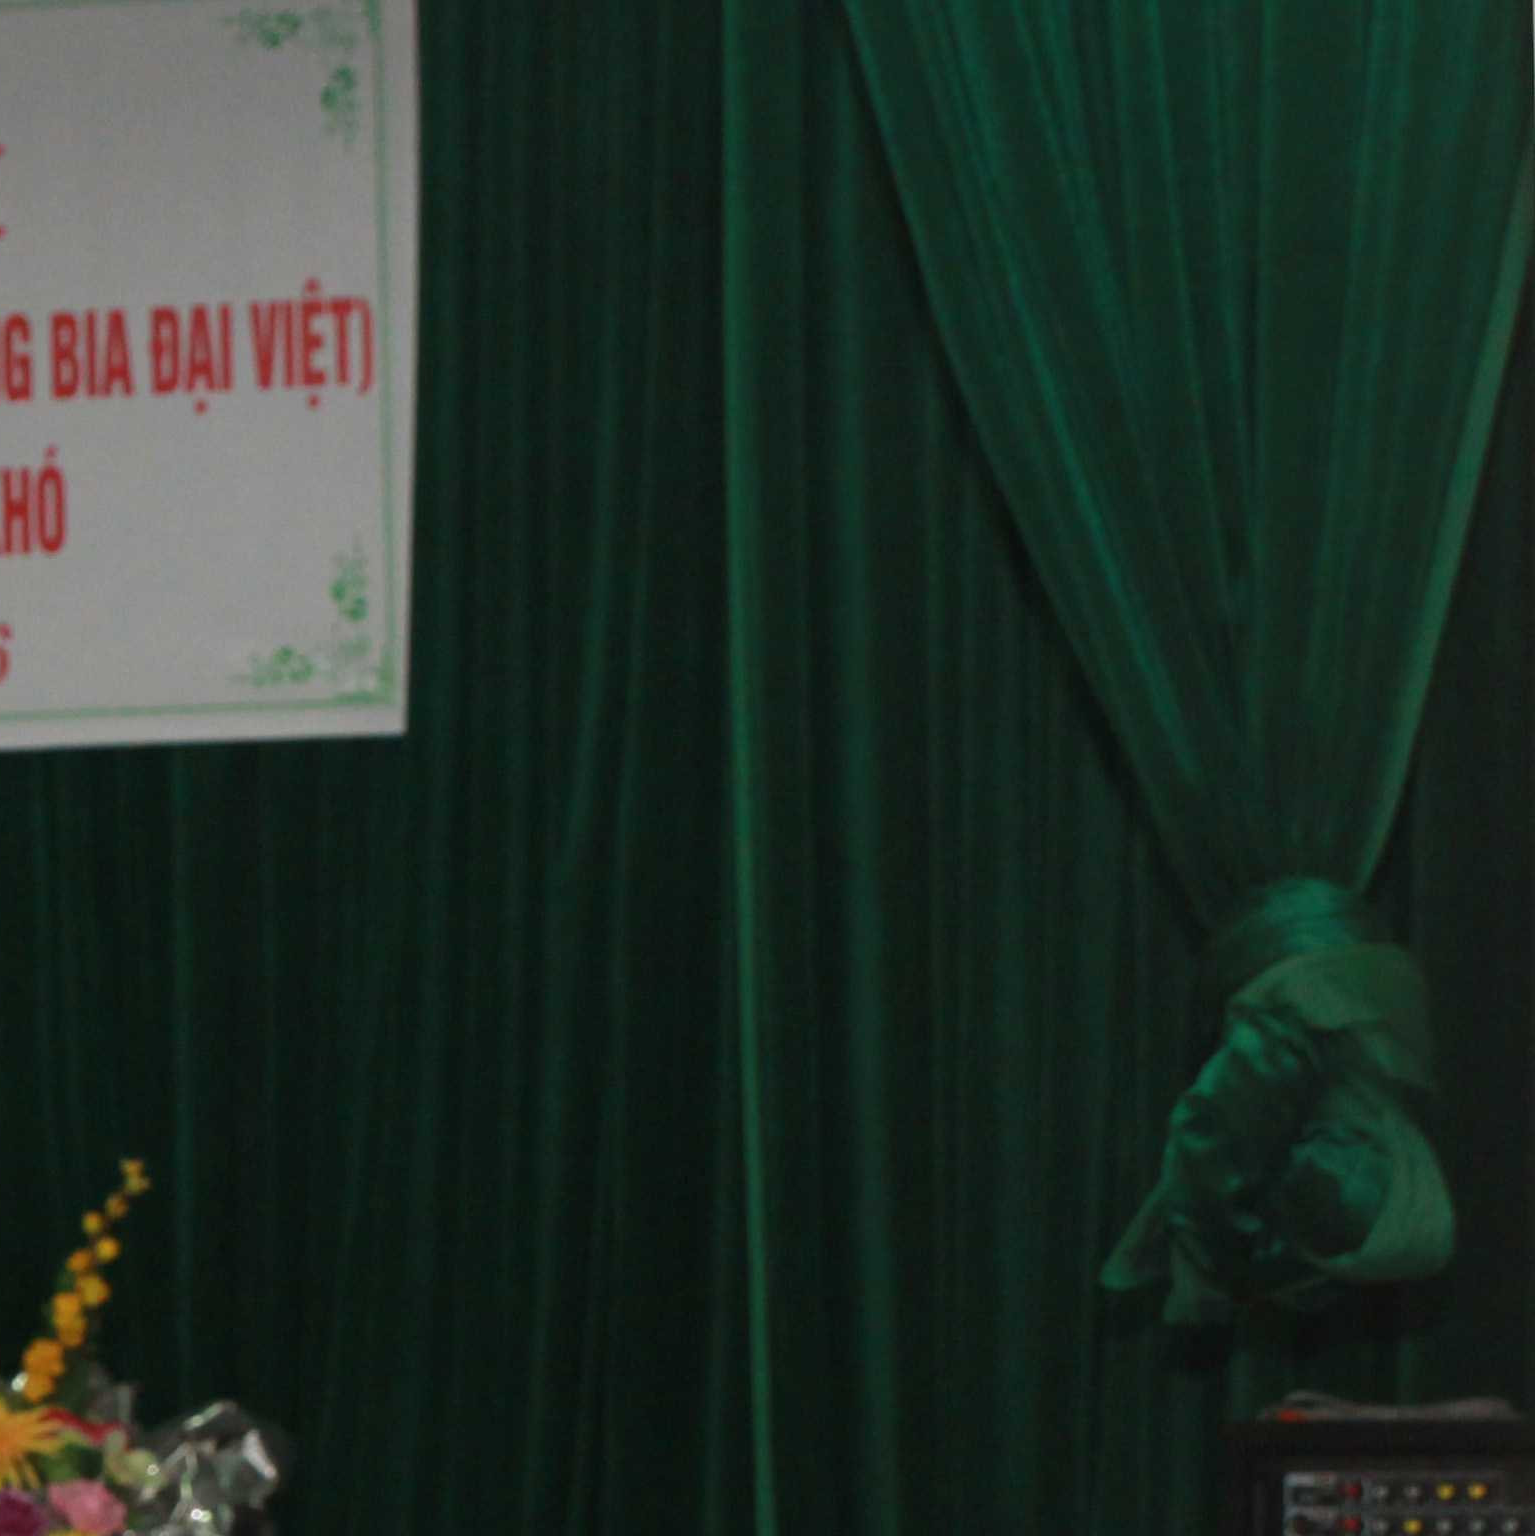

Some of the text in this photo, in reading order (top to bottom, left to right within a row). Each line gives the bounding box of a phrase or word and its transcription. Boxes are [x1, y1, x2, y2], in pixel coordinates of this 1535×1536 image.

[49, 306, 135, 400] BIA
[148, 301, 235, 415] ĐẠI
[249, 277, 374, 410] VIỆT)
